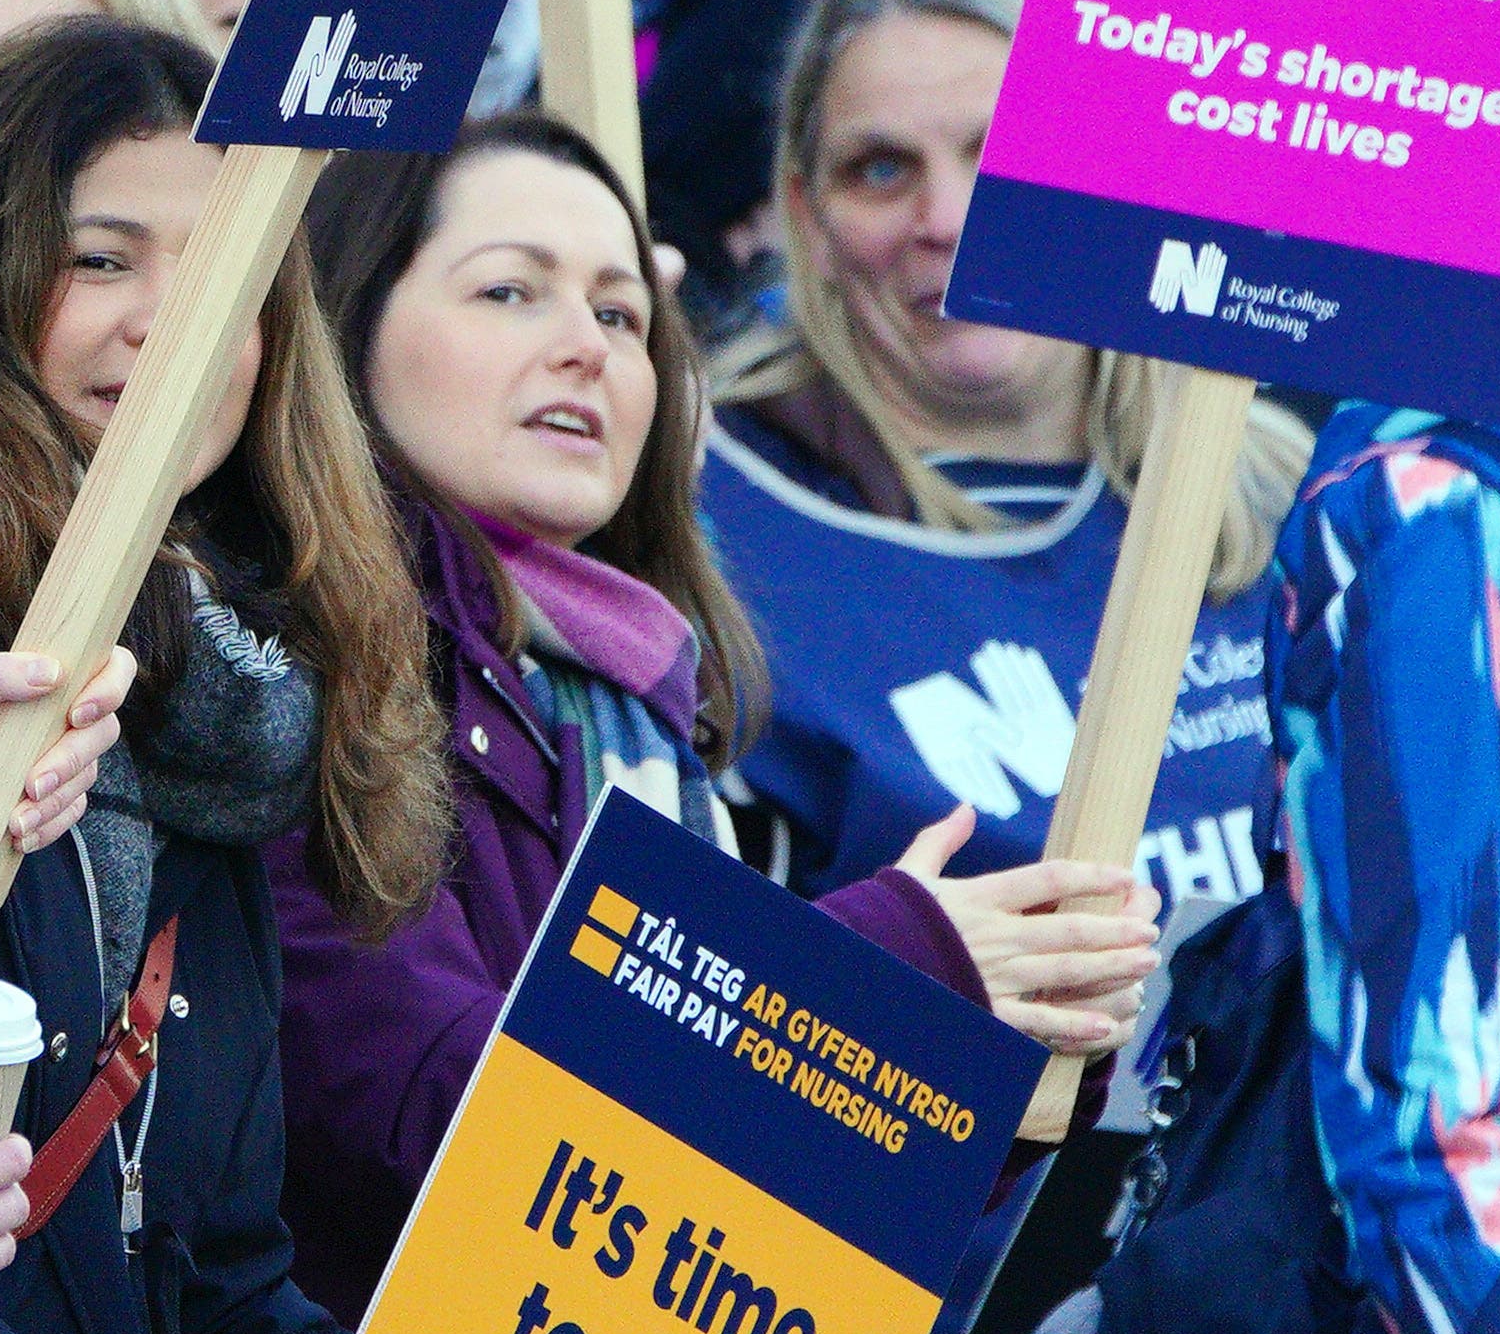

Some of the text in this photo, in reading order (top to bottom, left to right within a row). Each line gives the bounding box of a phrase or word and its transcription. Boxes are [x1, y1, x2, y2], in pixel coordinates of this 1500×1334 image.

[343, 53, 423, 91] Royal College
[330, 88, 393, 128] of Nursing
[1167, 89, 1413, 168] cost lives
[1228, 277, 1340, 321] Royal College
[1221, 301, 1309, 342] of Nursing
[636, 912, 975, 1142] TÂL TEG AR GYFER NYRSIO
[614, 953, 908, 1153] FAIR PAY FOR NURSING
